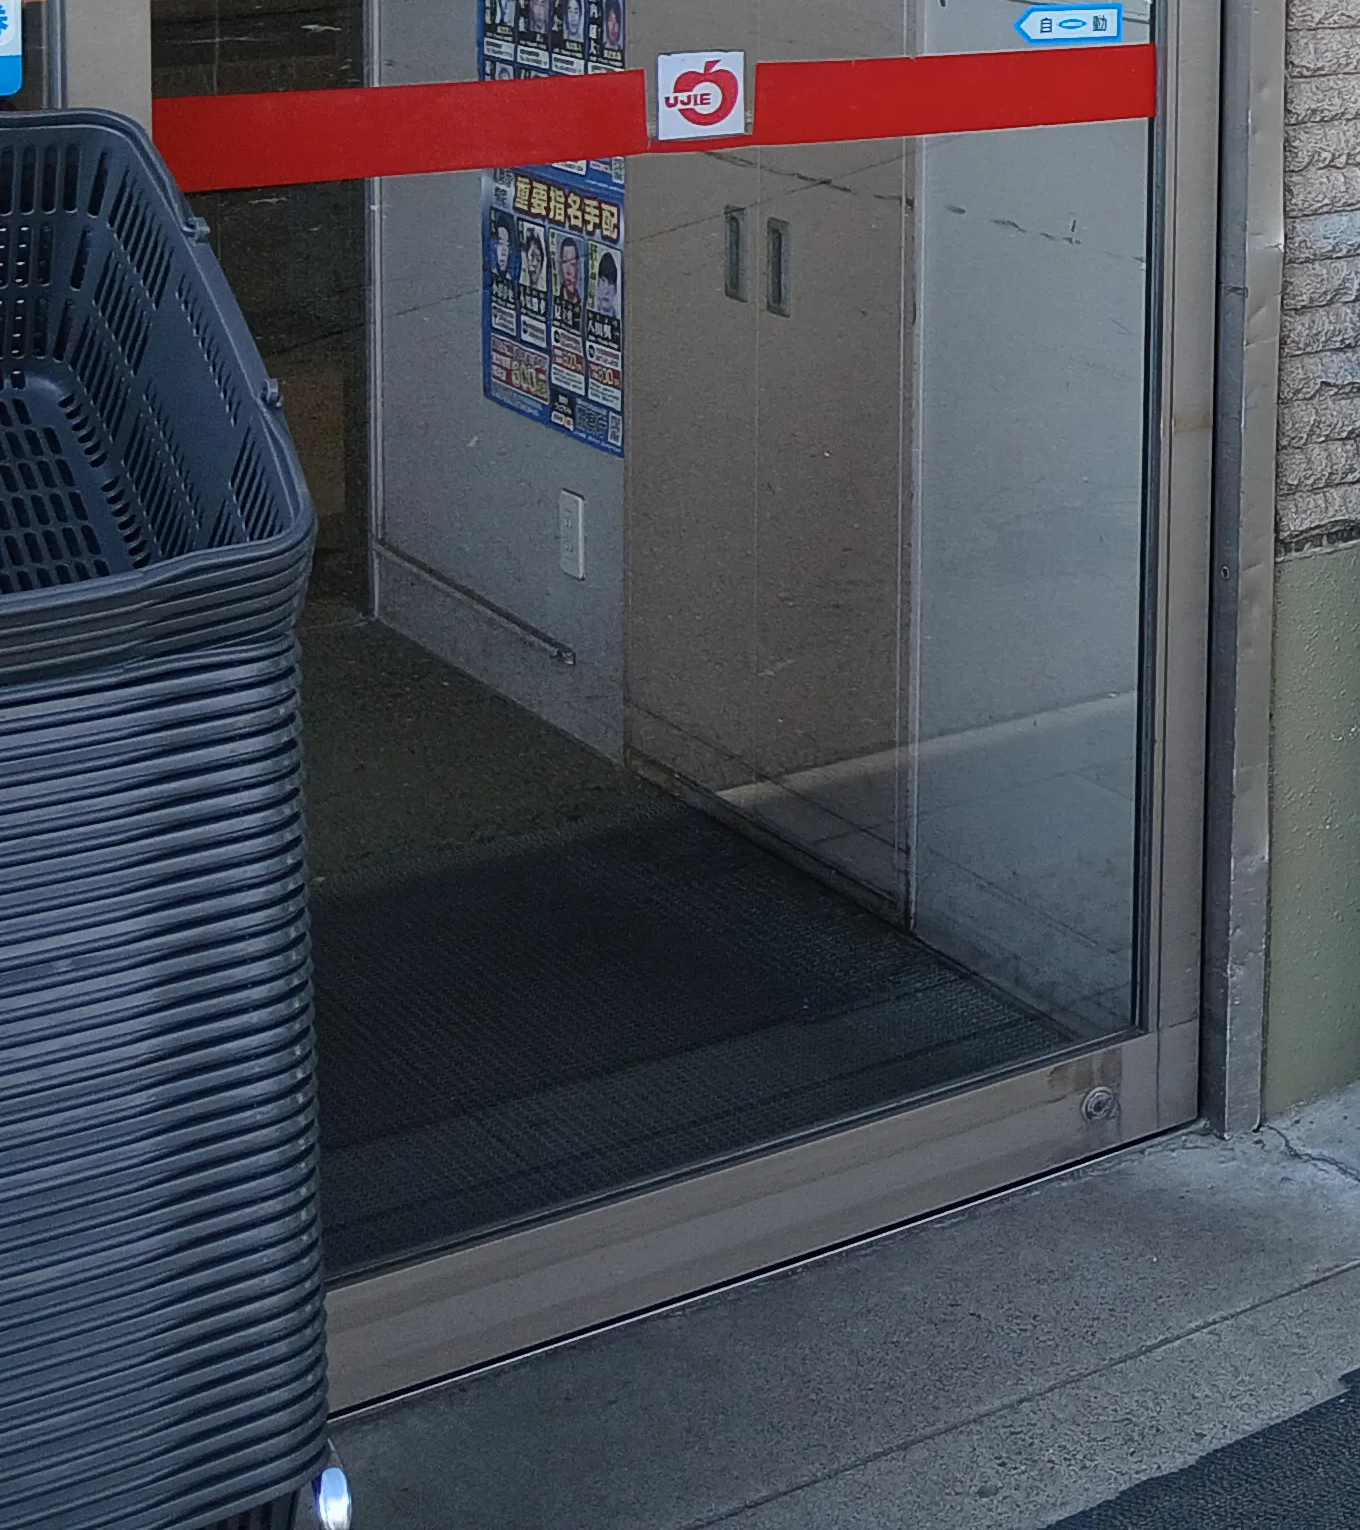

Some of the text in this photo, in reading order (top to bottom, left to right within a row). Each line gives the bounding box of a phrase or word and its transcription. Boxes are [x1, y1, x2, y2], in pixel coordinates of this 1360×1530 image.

[664, 93, 711, 108] UJIE
[514, 176, 619, 239] 重要指名手配
